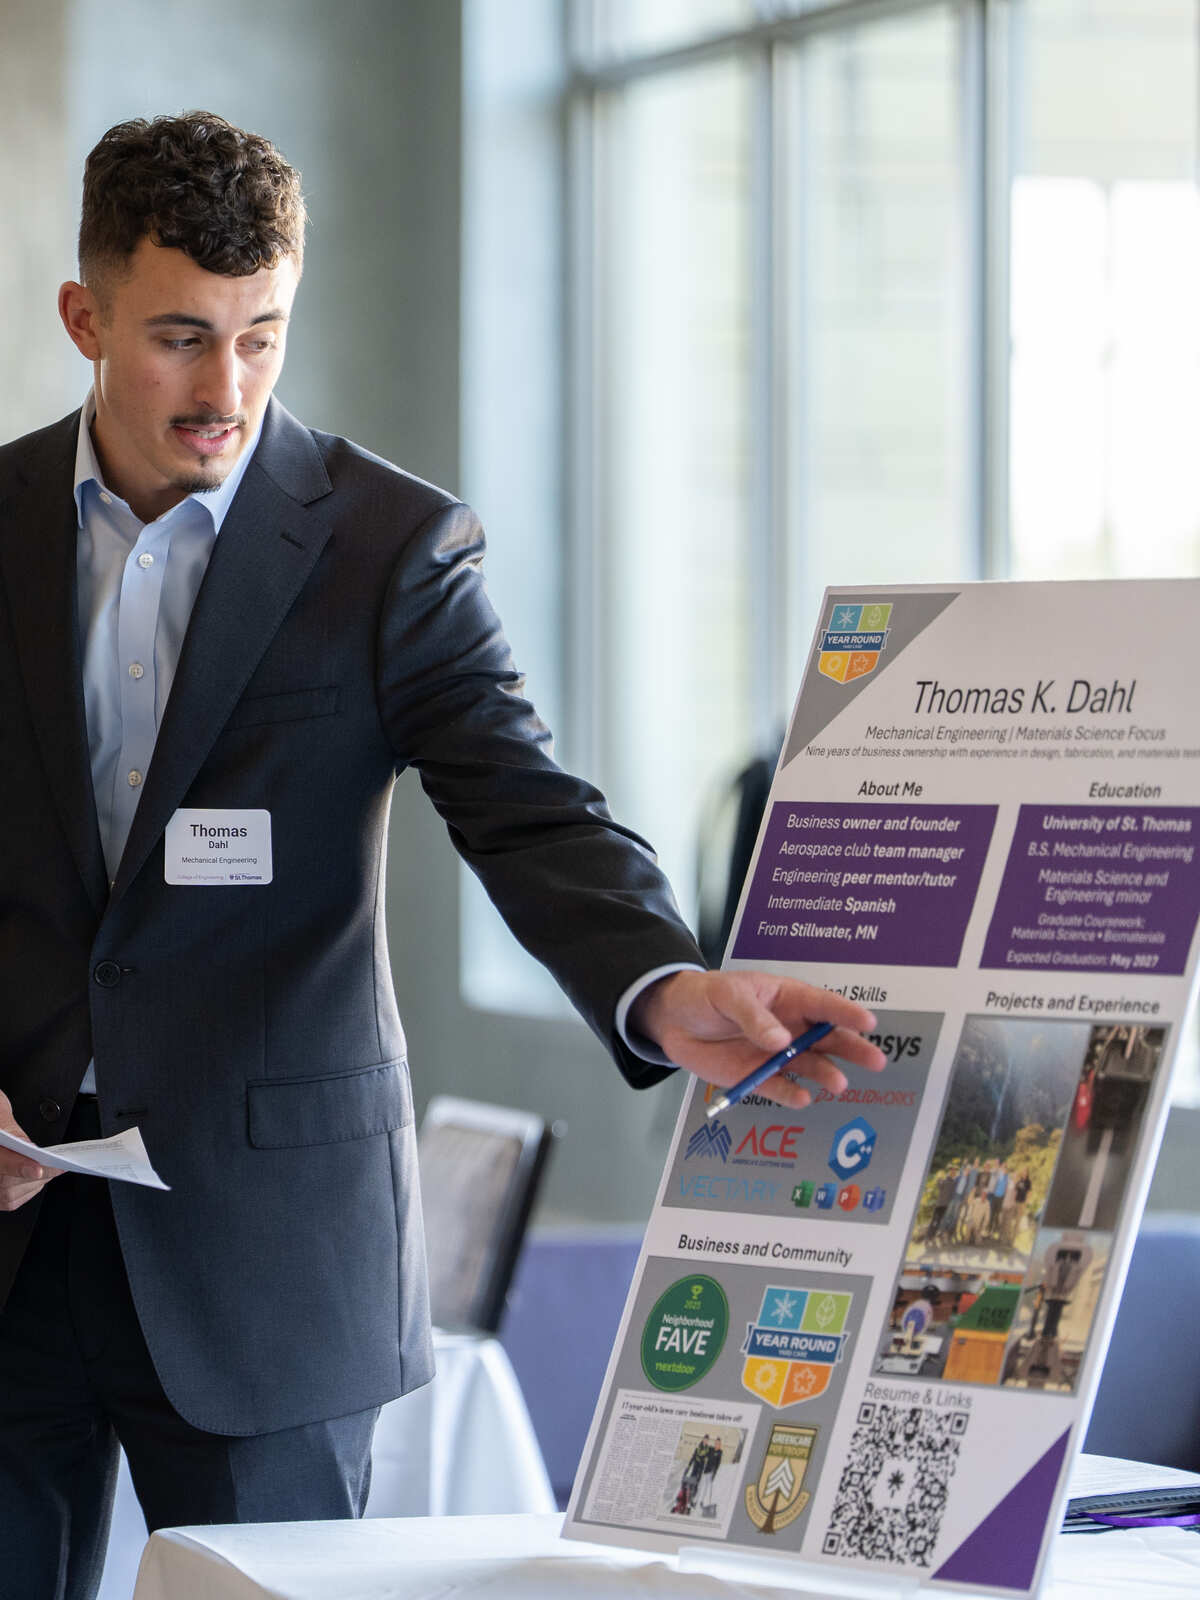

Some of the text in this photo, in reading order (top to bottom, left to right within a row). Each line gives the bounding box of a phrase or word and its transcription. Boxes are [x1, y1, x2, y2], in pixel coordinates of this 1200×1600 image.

[827, 636, 881, 644] YEAR ROUND
[914, 680, 1137, 714] Thomas K. Dahl
[865, 726, 934, 740] Mechanical
[936, 726, 1007, 743] Engineering
[1015, 726, 1072, 741] Materials
[1074, 726, 1128, 741] Science
[1128, 726, 1166, 741] Focus
[805, 746, 825, 756] Nine
[826, 747, 849, 758] years
[850, 746, 861, 757] of
[861, 746, 900, 757] business
[902, 747, 947, 759] ownership
[949, 747, 968, 757] with
[969, 748, 1017, 759] experience
[1019, 747, 1028, 758] in
[1117, 747, 1136, 758] and
[1136, 747, 1180, 758] materials
[858, 781, 923, 796] About Me
[1088, 782, 1162, 798] Education
[190, 824, 248, 838] Thomas
[787, 814, 960, 832] Business owner and founder
[1042, 815, 1192, 833] University of St. Thomas
[208, 840, 229, 849] Dahl
[779, 841, 964, 862] Aerospace club team manager
[1027, 842, 1194, 864] B.S. Mechanical Engineering
[219, 857, 258, 865] Engineering
[772, 867, 957, 888] Engineering peer mentor/tutor
[1038, 869, 1169, 887] Materials Science and
[767, 895, 896, 915] Intermediate Spanish
[1045, 887, 1152, 906] Engineering minor
[1038, 913, 1082, 927] Graduate
[757, 921, 878, 942] From Stillwater, MN
[1011, 928, 1166, 944] Materials Science Biomaterials
[1006, 950, 1051, 964] Expected
[1110, 954, 1131, 969] May
[849, 986, 887, 1002] Skills
[985, 991, 1160, 1015] Projects and Experience
[735, 1124, 805, 1159] ACE
[837, 1128, 872, 1169] C++
[678, 1234, 853, 1268] Business and Community
[662, 1313, 715, 1328] Neighborhood
[655, 1326, 711, 1355] FAVE
[755, 1333, 836, 1353] YEAR ROUND
[656, 1362, 696, 1374] nextdoor
[863, 1382, 972, 1409] Resume & Links
